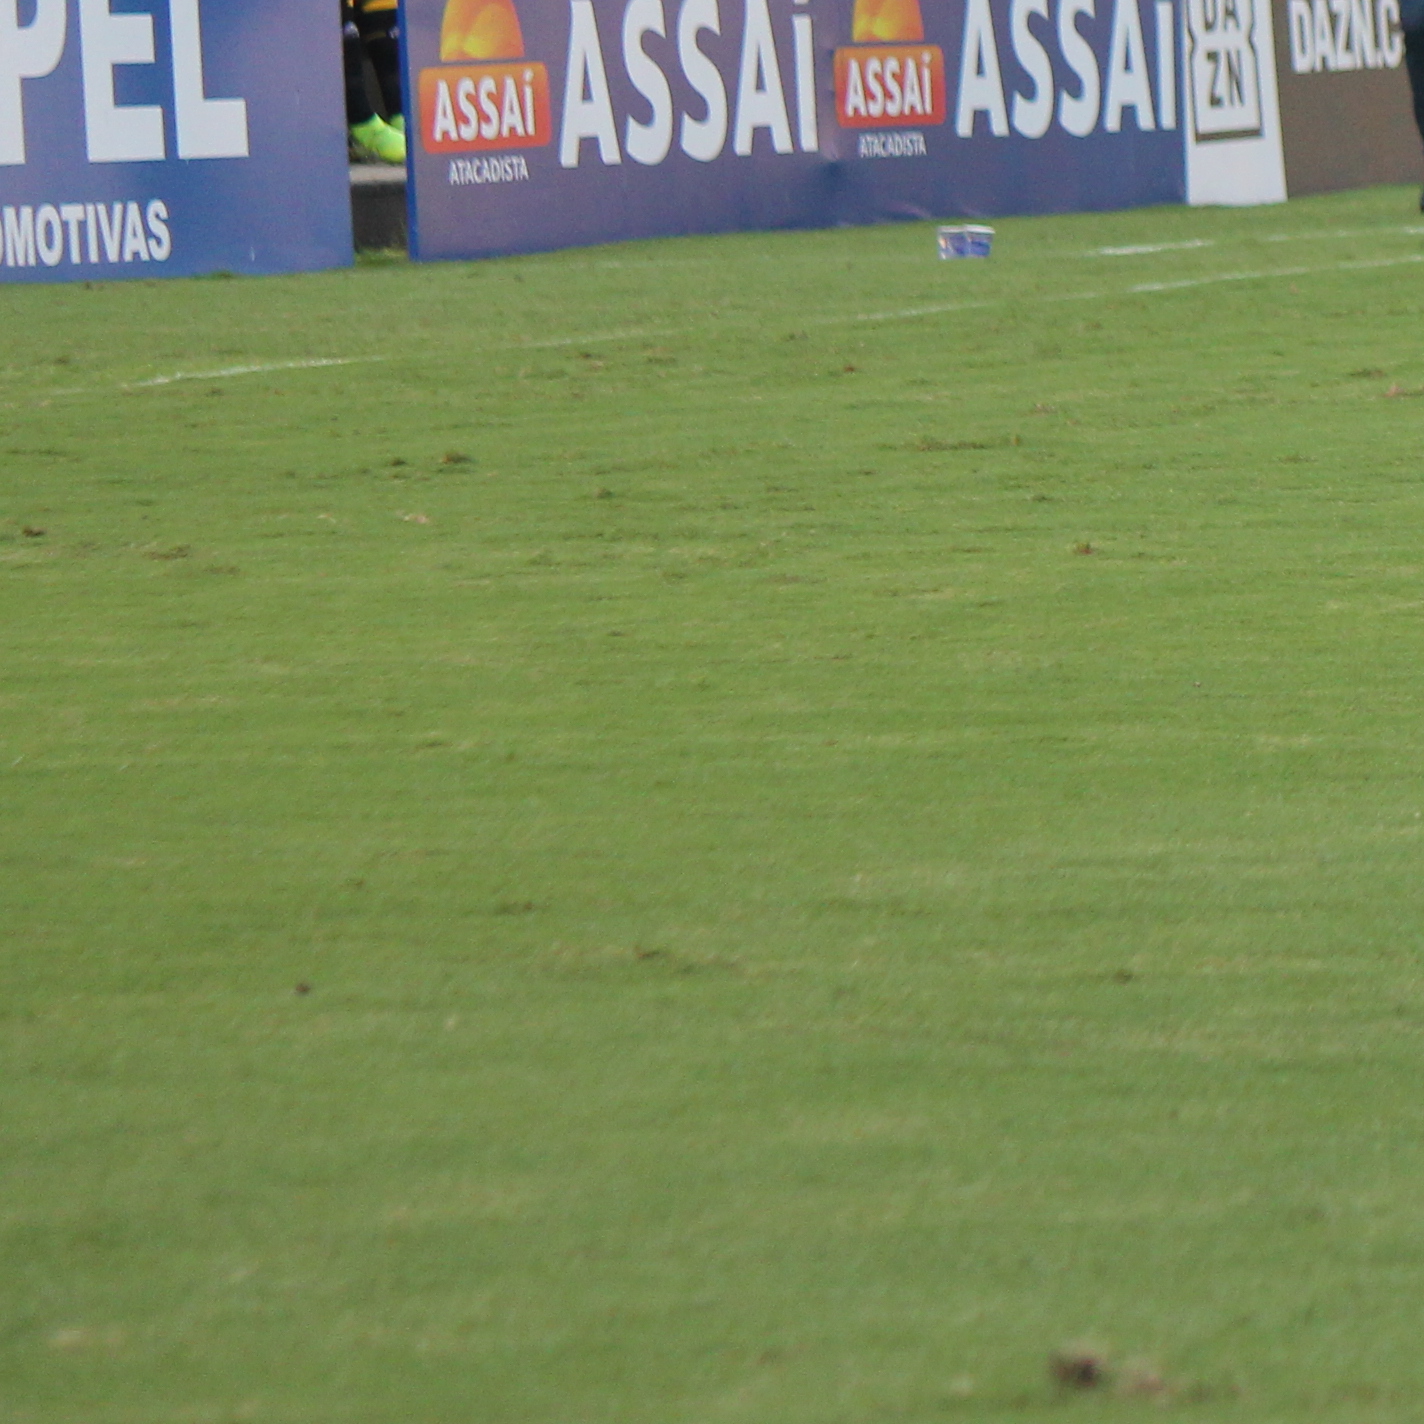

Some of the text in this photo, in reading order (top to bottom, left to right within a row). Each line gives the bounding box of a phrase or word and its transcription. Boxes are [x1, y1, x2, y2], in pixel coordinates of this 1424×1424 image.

[859, 130, 927, 159] ATACADISTA
[448, 156, 530, 185] ATACADISTA
[0, 198, 172, 267] MOTIVAS
